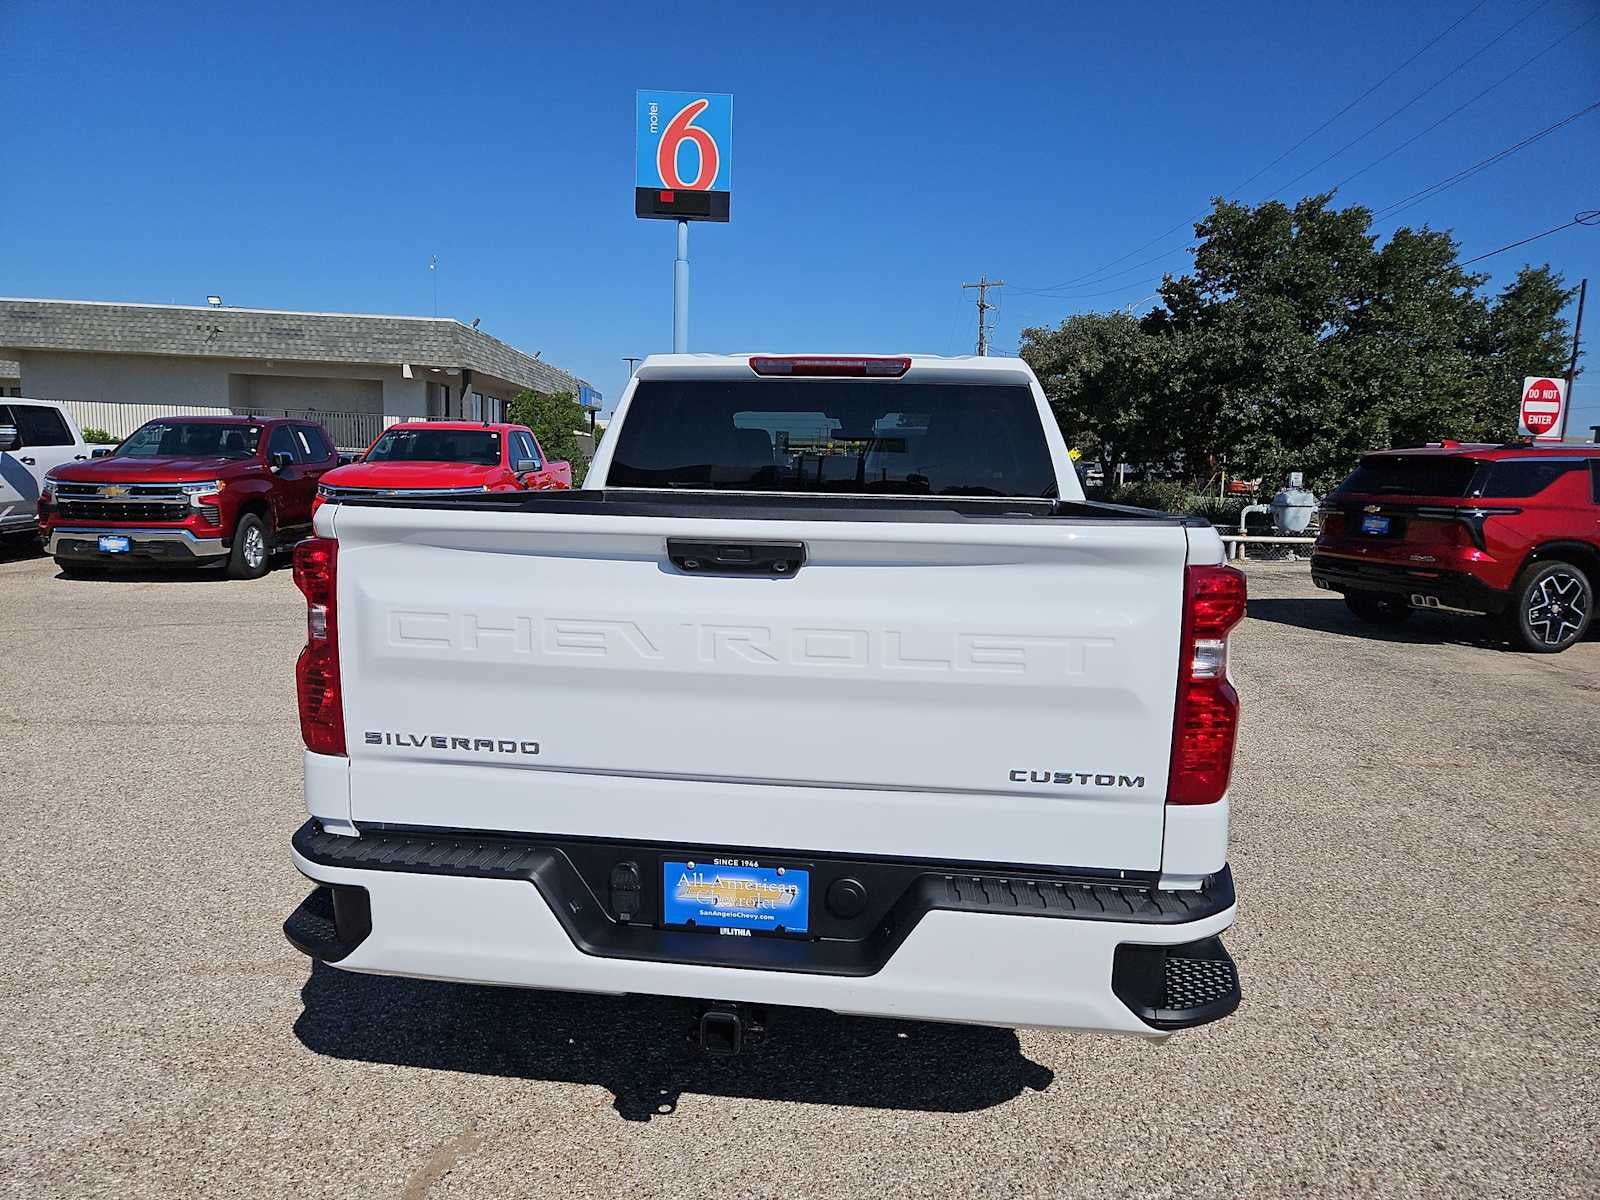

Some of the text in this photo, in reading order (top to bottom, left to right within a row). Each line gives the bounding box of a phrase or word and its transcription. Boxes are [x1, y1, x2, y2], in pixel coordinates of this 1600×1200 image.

[649, 102, 658, 133] motel
[656, 98, 720, 190] 6
[1529, 390, 1558, 399] DO NOT
[1528, 415, 1552, 424] ENTER
[388, 610, 1116, 676] CHEVROLET
[364, 731, 540, 755] SILVERADO
[1009, 769, 1145, 788] CUSTOM
[713, 858, 759, 868] SINCE 1946
[676, 872, 799, 894] All American
[696, 890, 777, 910] Chevrolet
[699, 909, 775, 921] SanAngeloChevy.com
